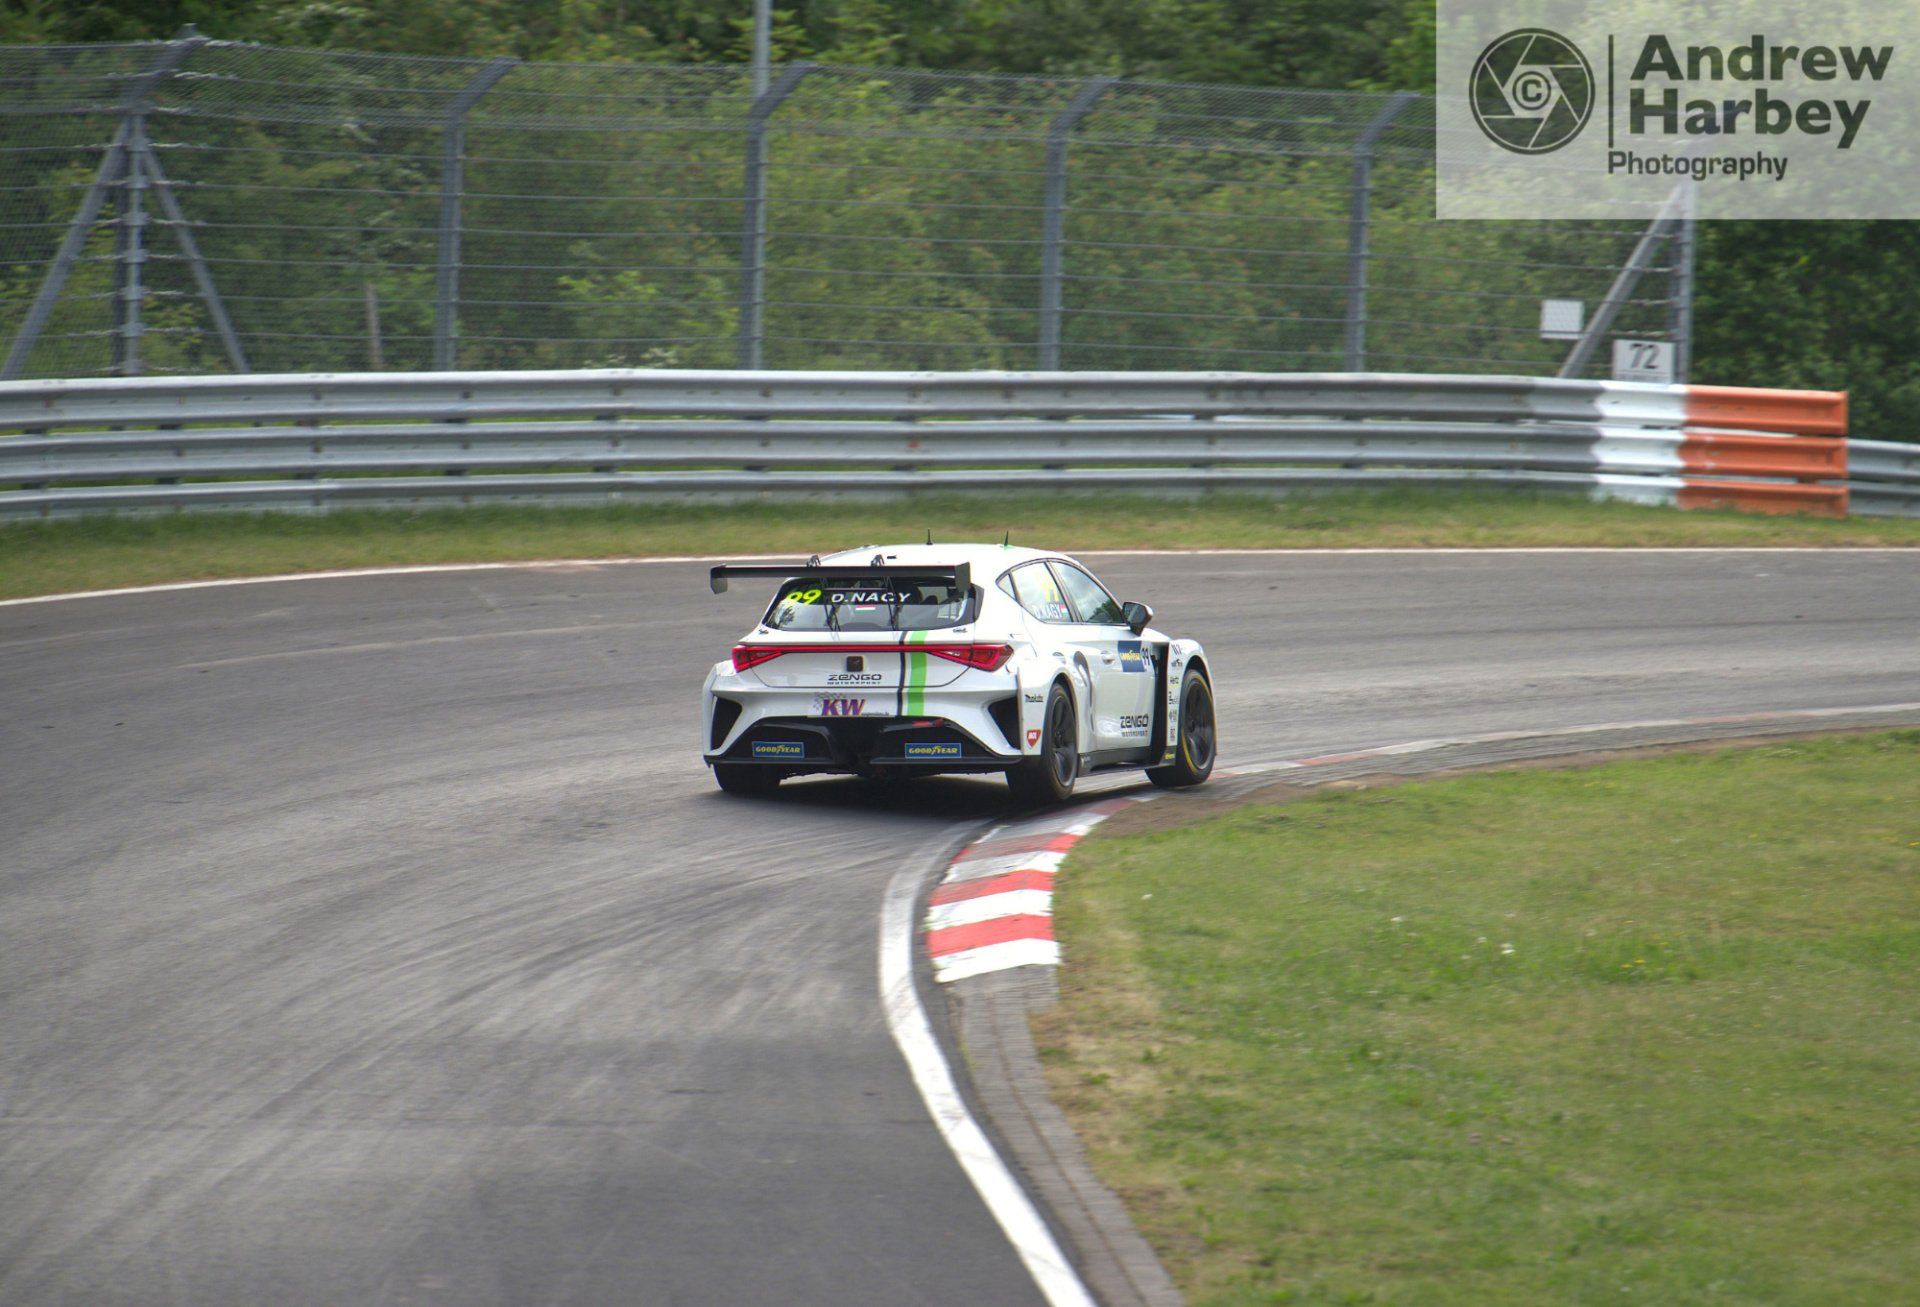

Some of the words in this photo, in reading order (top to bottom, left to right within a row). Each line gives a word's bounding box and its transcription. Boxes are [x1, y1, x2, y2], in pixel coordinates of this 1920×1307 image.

[1630, 343, 1660, 369] 72
[821, 699, 865, 716] KW
[755, 744, 801, 755] GOODYEAR
[908, 745, 959, 756] GOODYEAR
